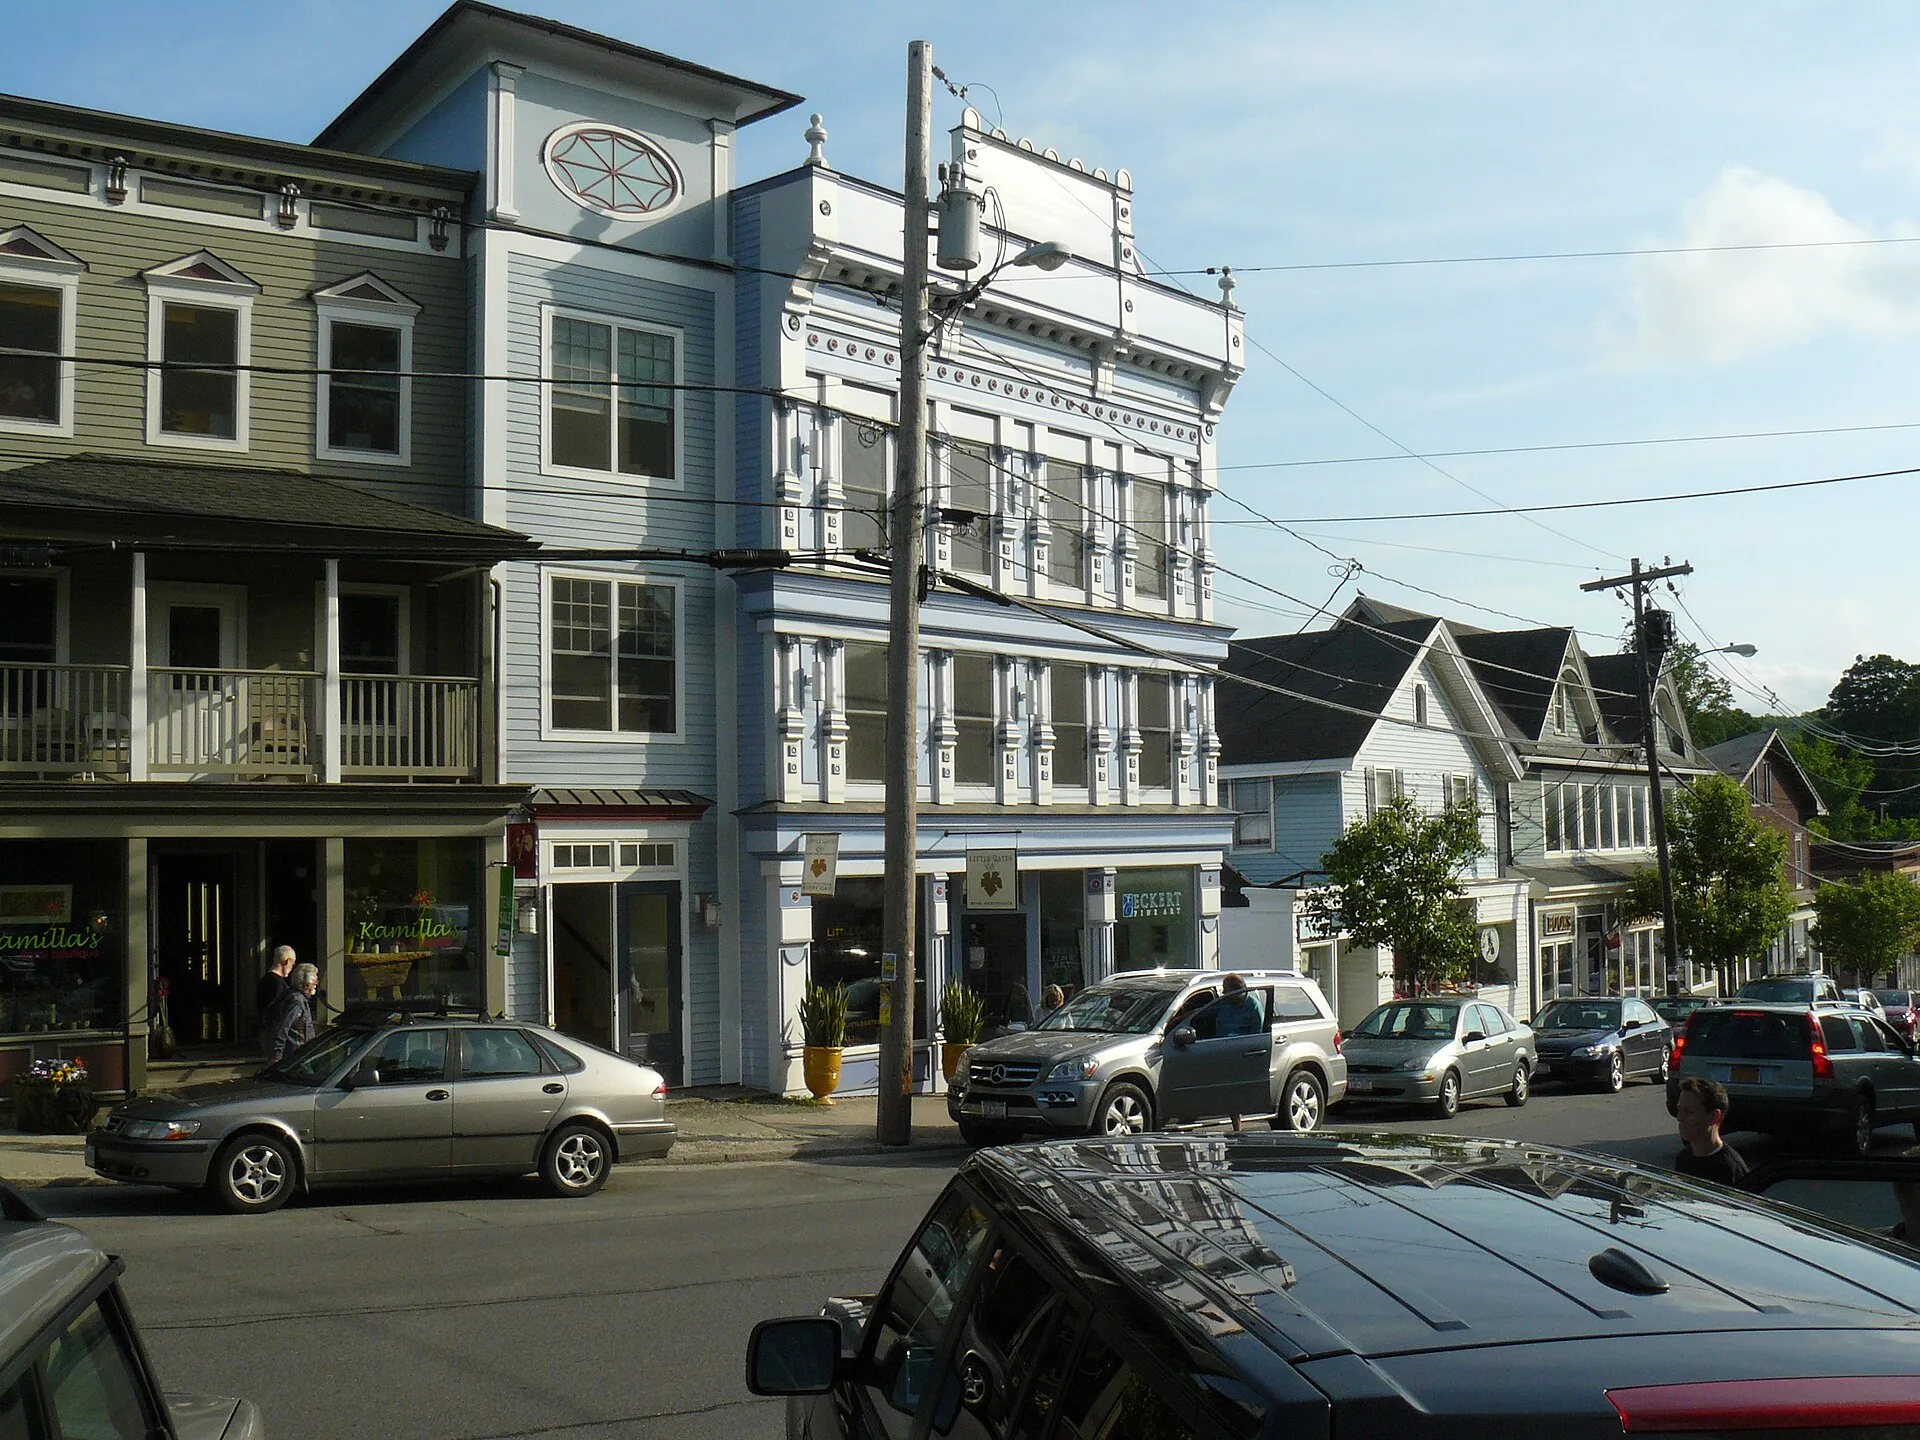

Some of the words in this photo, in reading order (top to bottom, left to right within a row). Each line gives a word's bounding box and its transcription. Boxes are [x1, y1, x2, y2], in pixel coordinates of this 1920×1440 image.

[969, 855, 992, 863] LITTLE
[1133, 891, 1182, 909] ECKERT
[1133, 908, 1158, 918] FINE
[1162, 907, 1181, 916] ART
[0, 926, 104, 950] amilla's
[359, 918, 461, 941] Kamilla's
